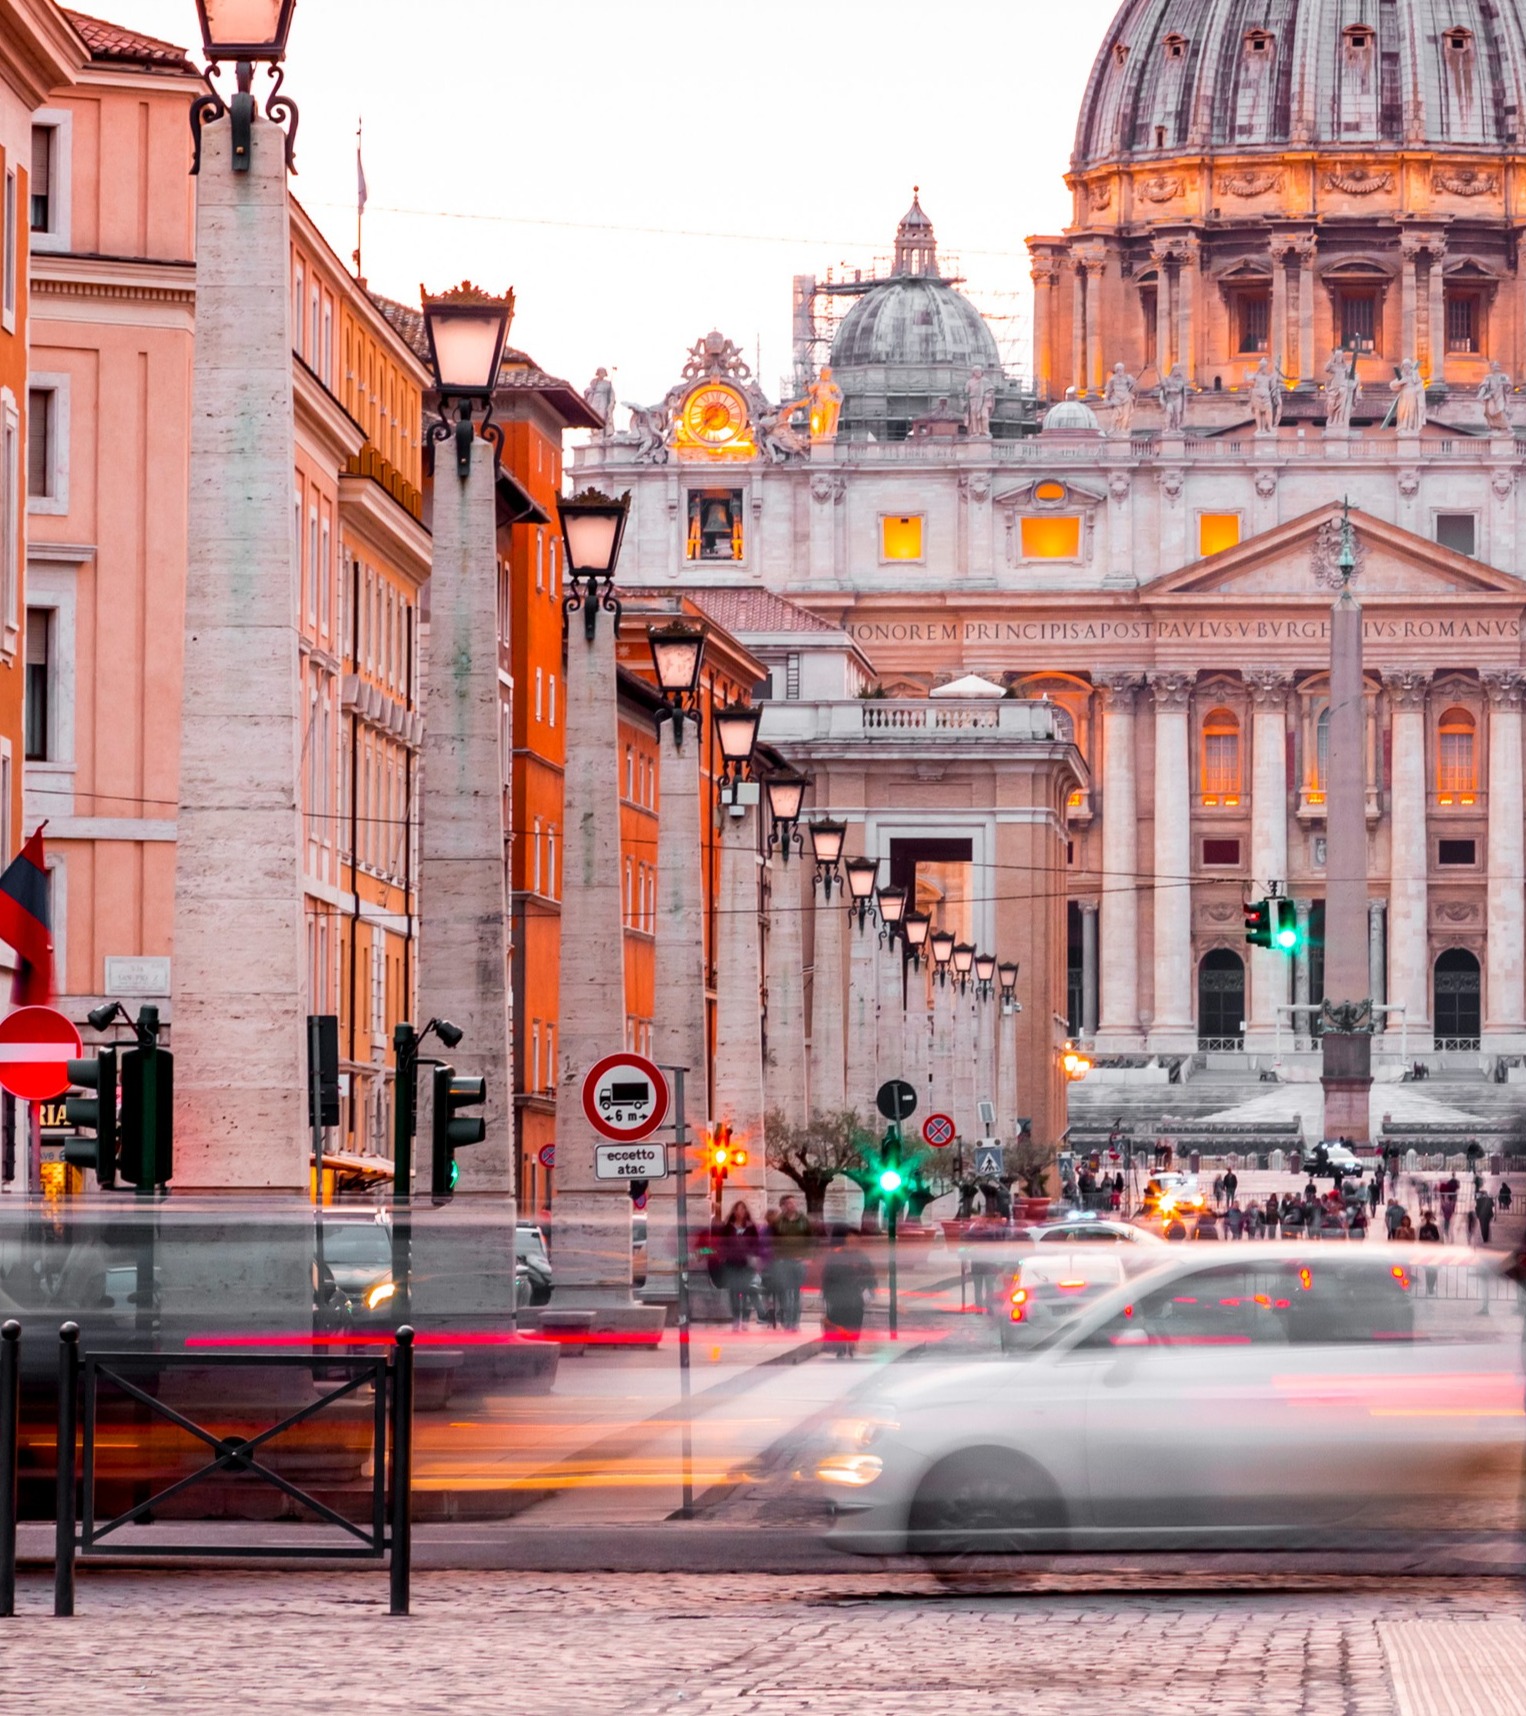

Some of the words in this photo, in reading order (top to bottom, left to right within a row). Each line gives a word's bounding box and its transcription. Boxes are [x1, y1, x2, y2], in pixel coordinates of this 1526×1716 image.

[1403, 620, 1519, 638] ROMANVS
[40, 1104, 72, 1126] RIA
[615, 1109, 623, 1122] 6
[628, 1112, 638, 1122] m
[607, 1148, 655, 1161] eccetto
[617, 1163, 645, 1175] atac
